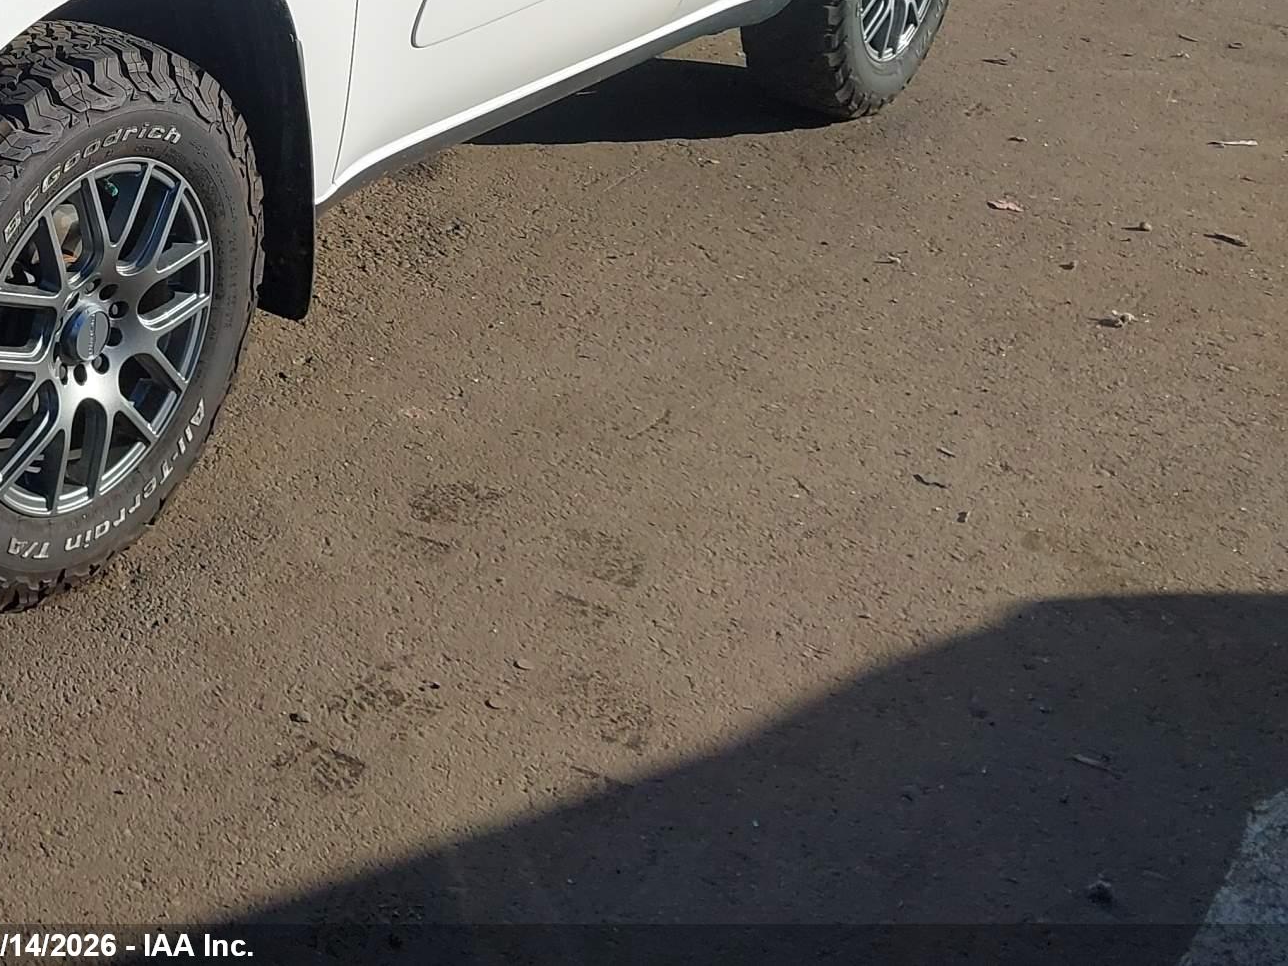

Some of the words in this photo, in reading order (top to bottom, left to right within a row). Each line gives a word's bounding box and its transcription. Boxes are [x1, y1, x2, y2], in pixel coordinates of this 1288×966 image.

[3, 121, 182, 243] BFGoodrich
[64, 398, 206, 551] All-Terrain
[7, 537, 51, 560] T/A
